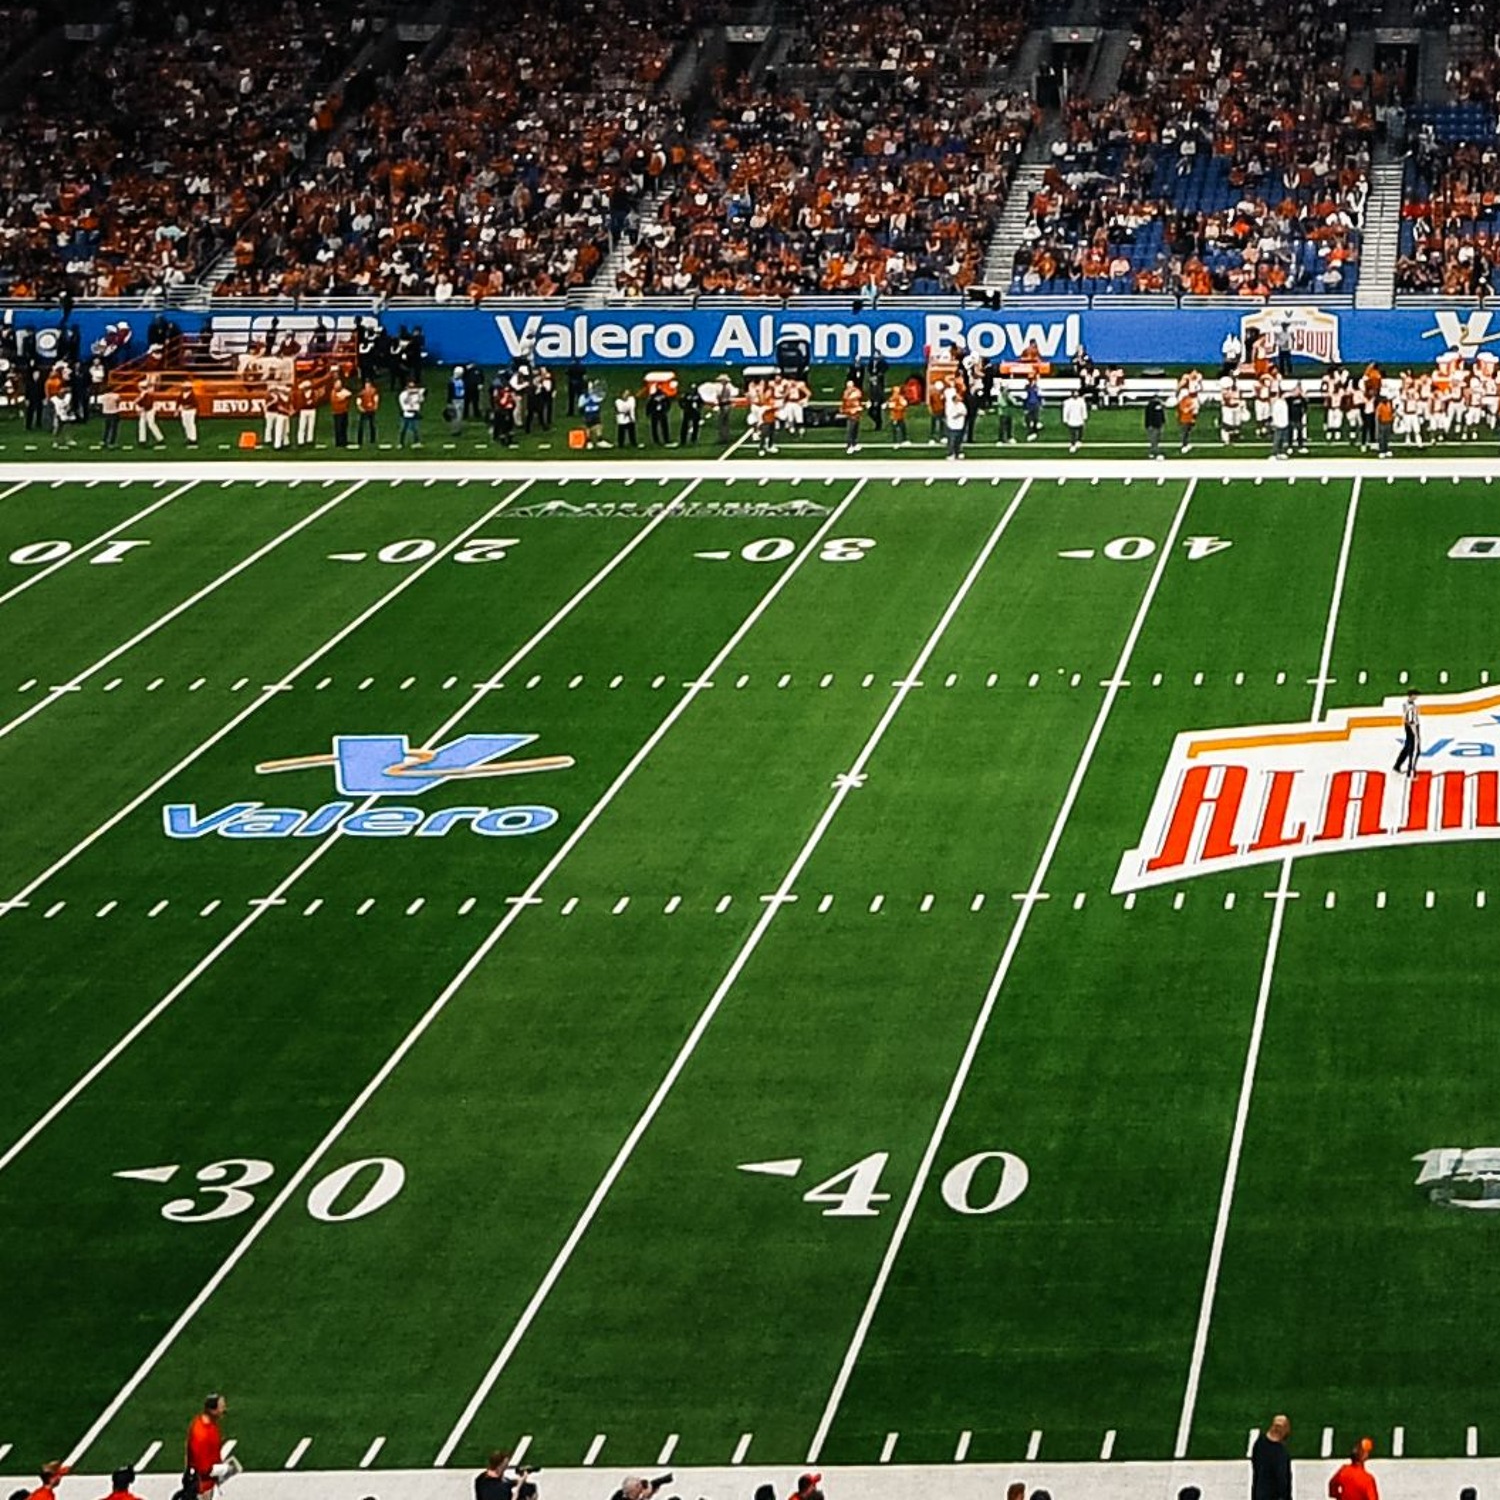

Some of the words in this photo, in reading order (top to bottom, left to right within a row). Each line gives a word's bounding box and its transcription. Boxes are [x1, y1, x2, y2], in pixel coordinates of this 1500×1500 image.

[495, 314, 694, 358] Valero
[925, 314, 1079, 358] Bowl
[163, 802, 559, 838] Valero
[161, 1157, 406, 1223] 30
[802, 1150, 1030, 1216] 40
